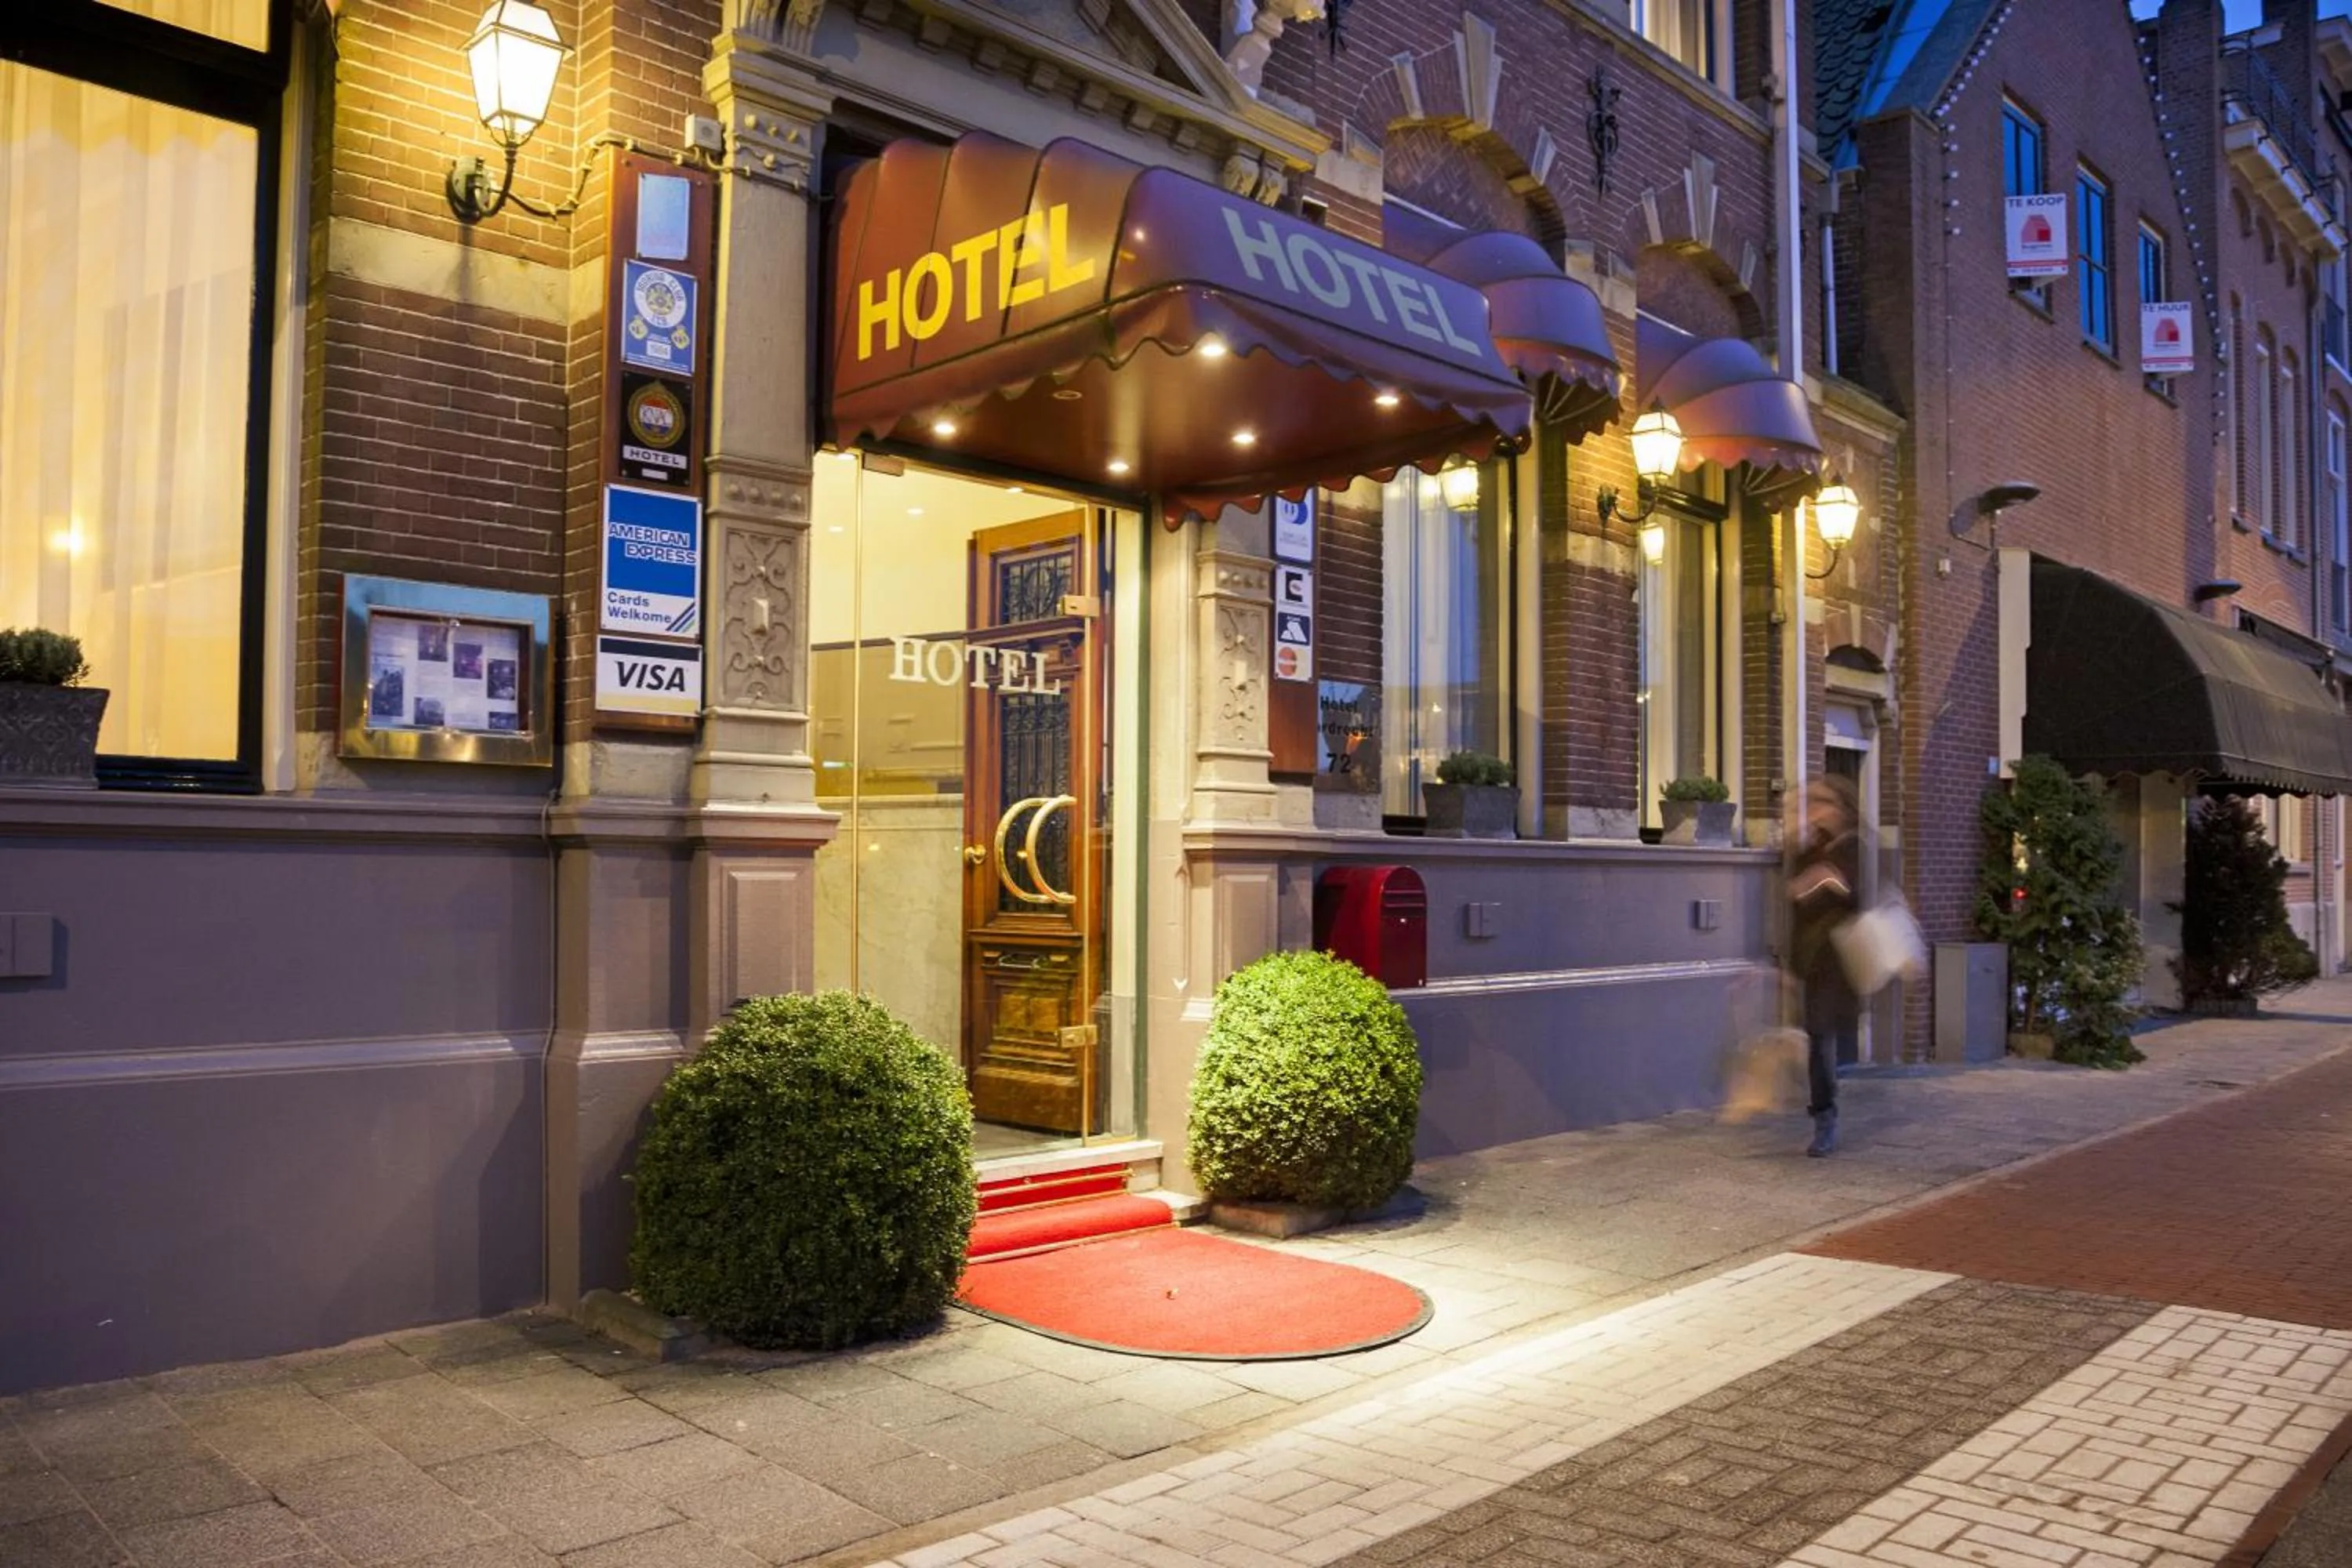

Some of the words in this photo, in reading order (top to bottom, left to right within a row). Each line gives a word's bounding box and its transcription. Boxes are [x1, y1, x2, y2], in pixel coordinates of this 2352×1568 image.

[2008, 198, 2023, 208] TE
[2027, 195, 2063, 206] KOOP
[858, 202, 1095, 361] HOTEL
[1221, 206, 1483, 357] HOTEL
[629, 448, 680, 466] HOTEL
[608, 521, 690, 547] AMERICAN
[625, 543, 697, 565] EXPRESS
[608, 591, 651, 608] Cards
[608, 606, 672, 624] Welkome
[889, 634, 1061, 695] HOTEL
[615, 660, 686, 692] VISA
[1320, 695, 1358, 714] Hotel
[1326, 753, 1351, 774] 72
